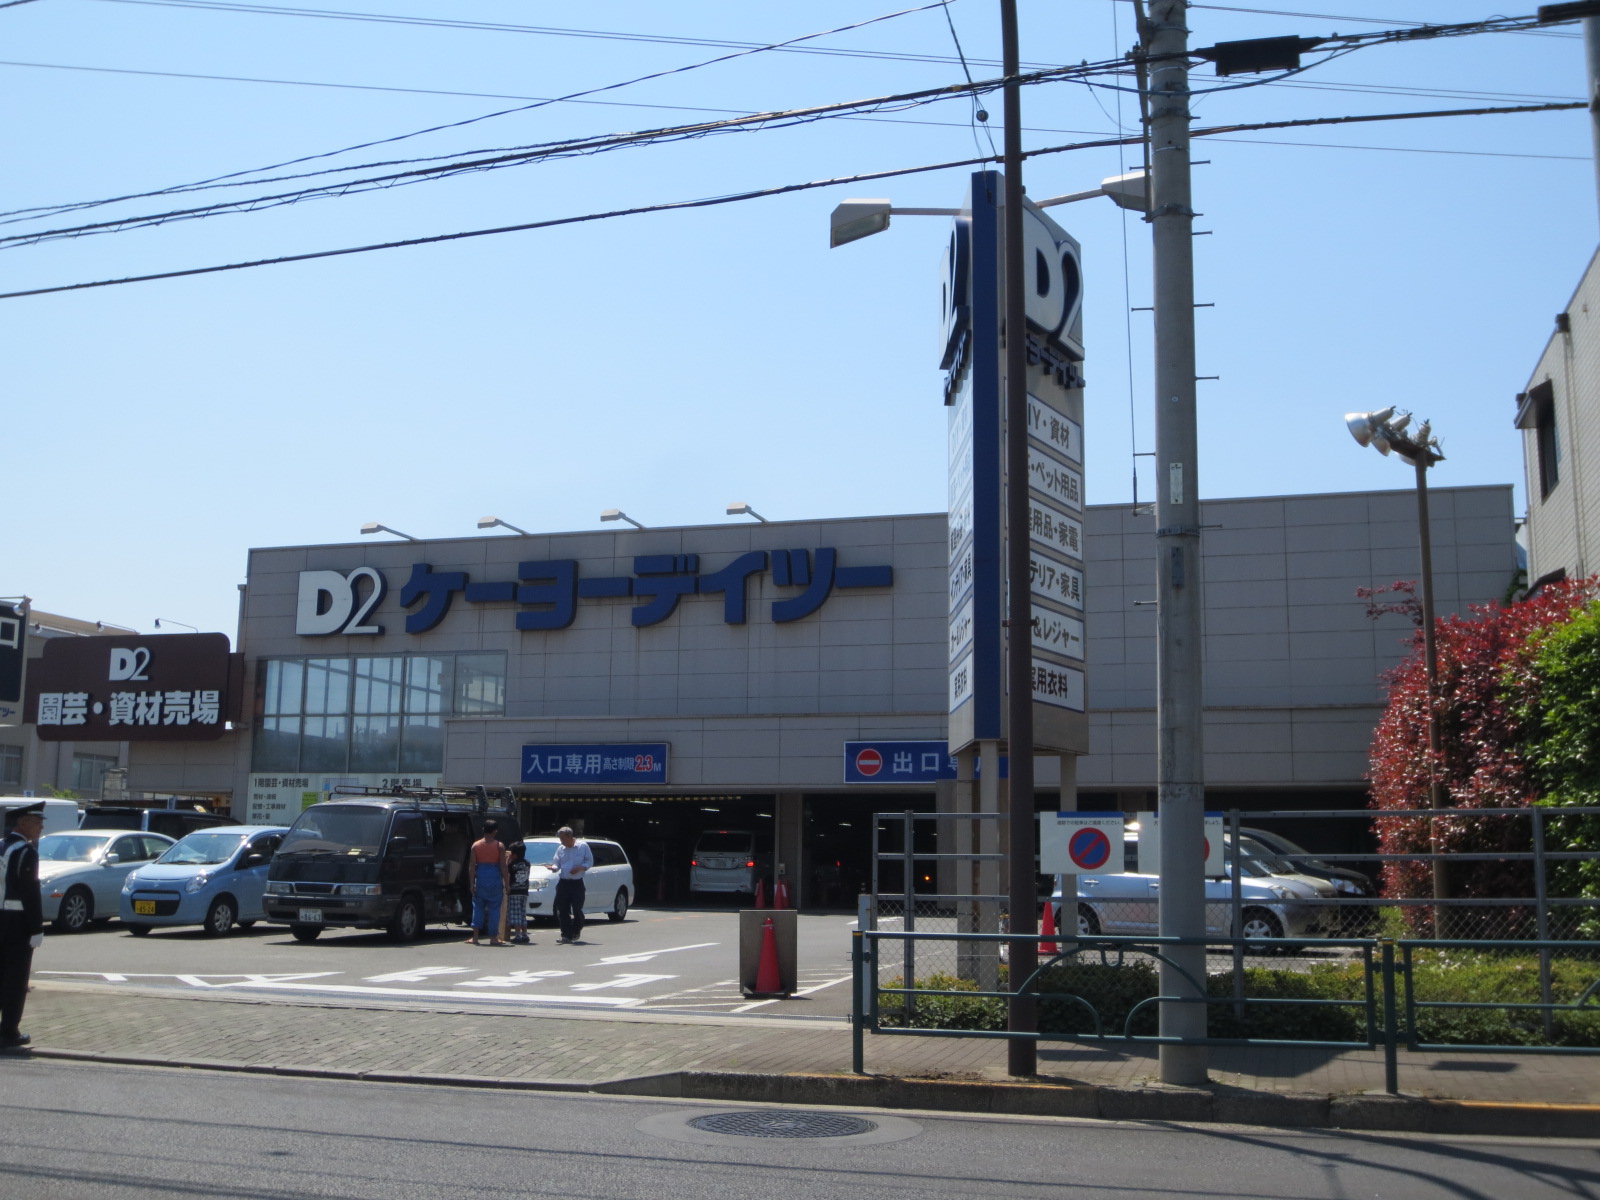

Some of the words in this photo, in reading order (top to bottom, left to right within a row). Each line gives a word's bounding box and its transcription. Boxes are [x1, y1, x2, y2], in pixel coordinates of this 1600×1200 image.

[1023, 204, 1086, 361] D2
[1027, 403, 1070, 449] IY・資材
[1028, 453, 1079, 503] ・ペット用品
[296, 566, 387, 636] D2
[109, 646, 151, 681] D2
[0, 706, 16, 718] ツー
[37, 689, 220, 726] 園芸・資材売場
[527, 754, 601, 774] 入口専用
[603, 757, 635, 771] 高さ制限
